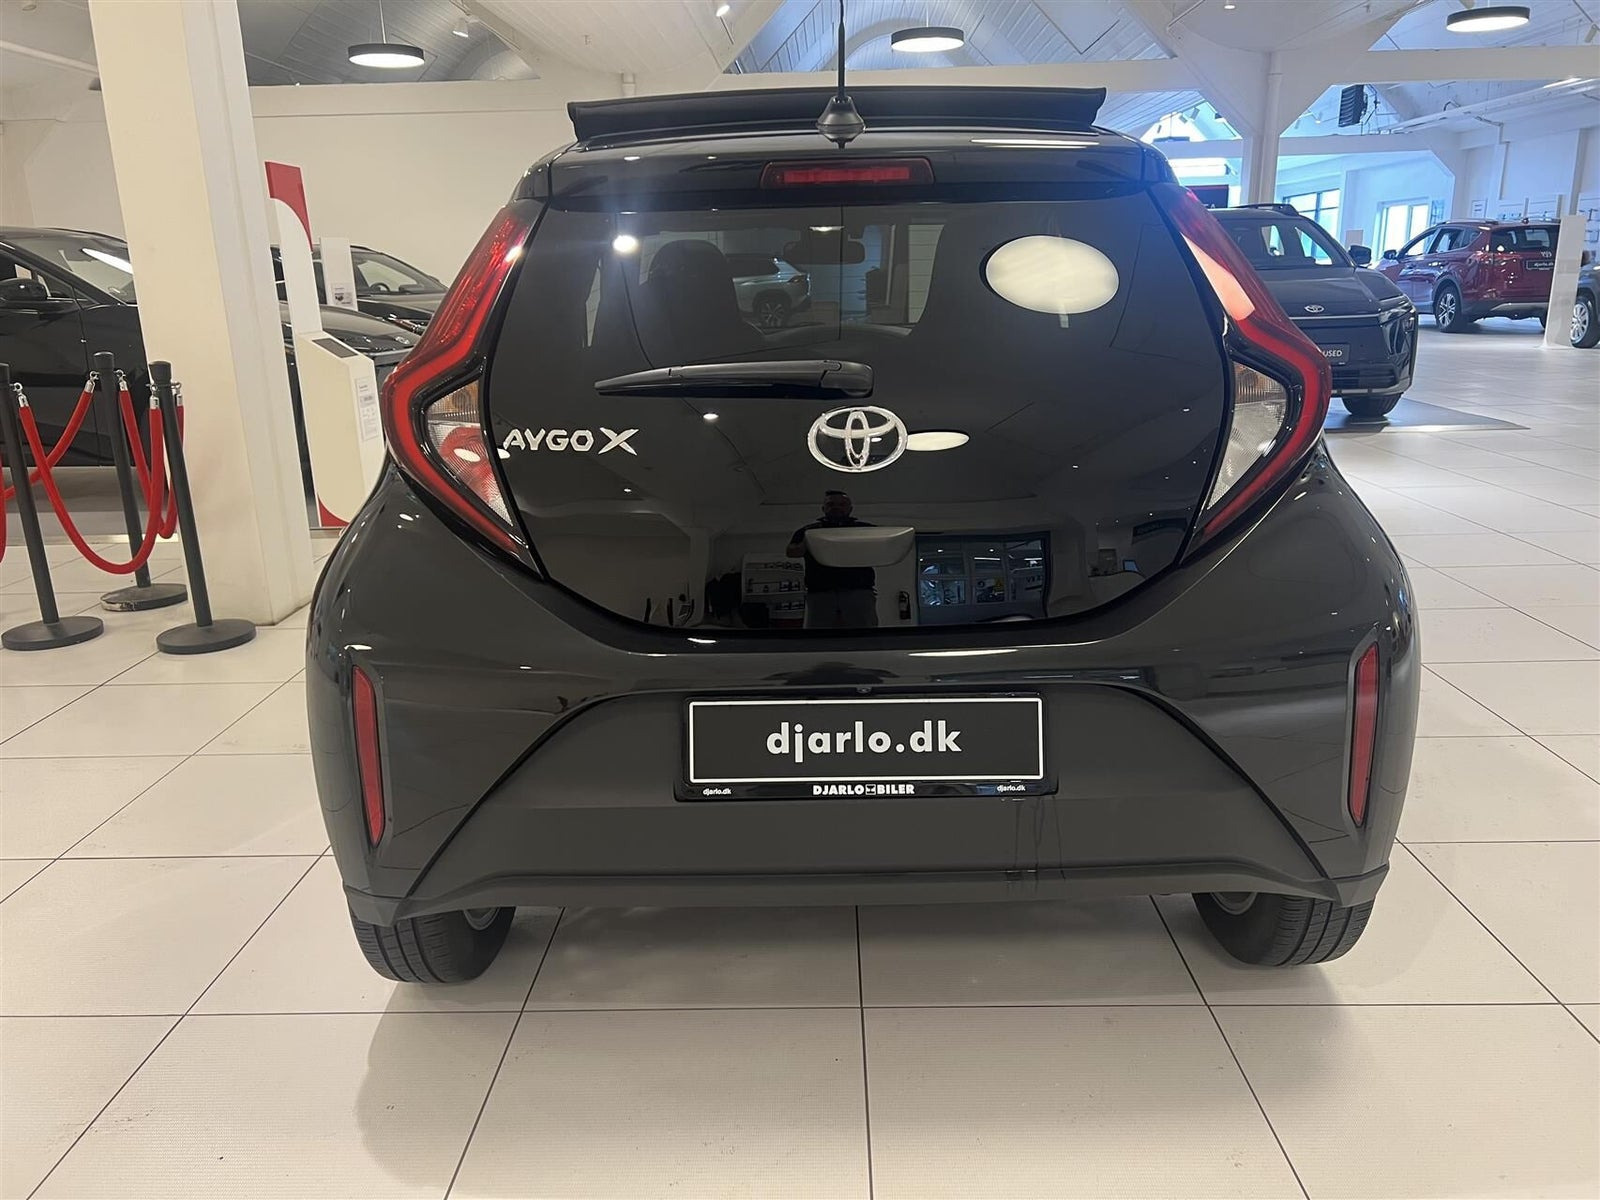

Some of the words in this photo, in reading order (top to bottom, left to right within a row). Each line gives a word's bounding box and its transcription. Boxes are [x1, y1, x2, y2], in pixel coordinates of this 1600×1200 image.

[502, 428, 594, 452] AYGO
[598, 427, 640, 456] X
[766, 720, 962, 763] djarlo.dk
[812, 784, 865, 795] DJARLO
[877, 784, 915, 795] BILER
